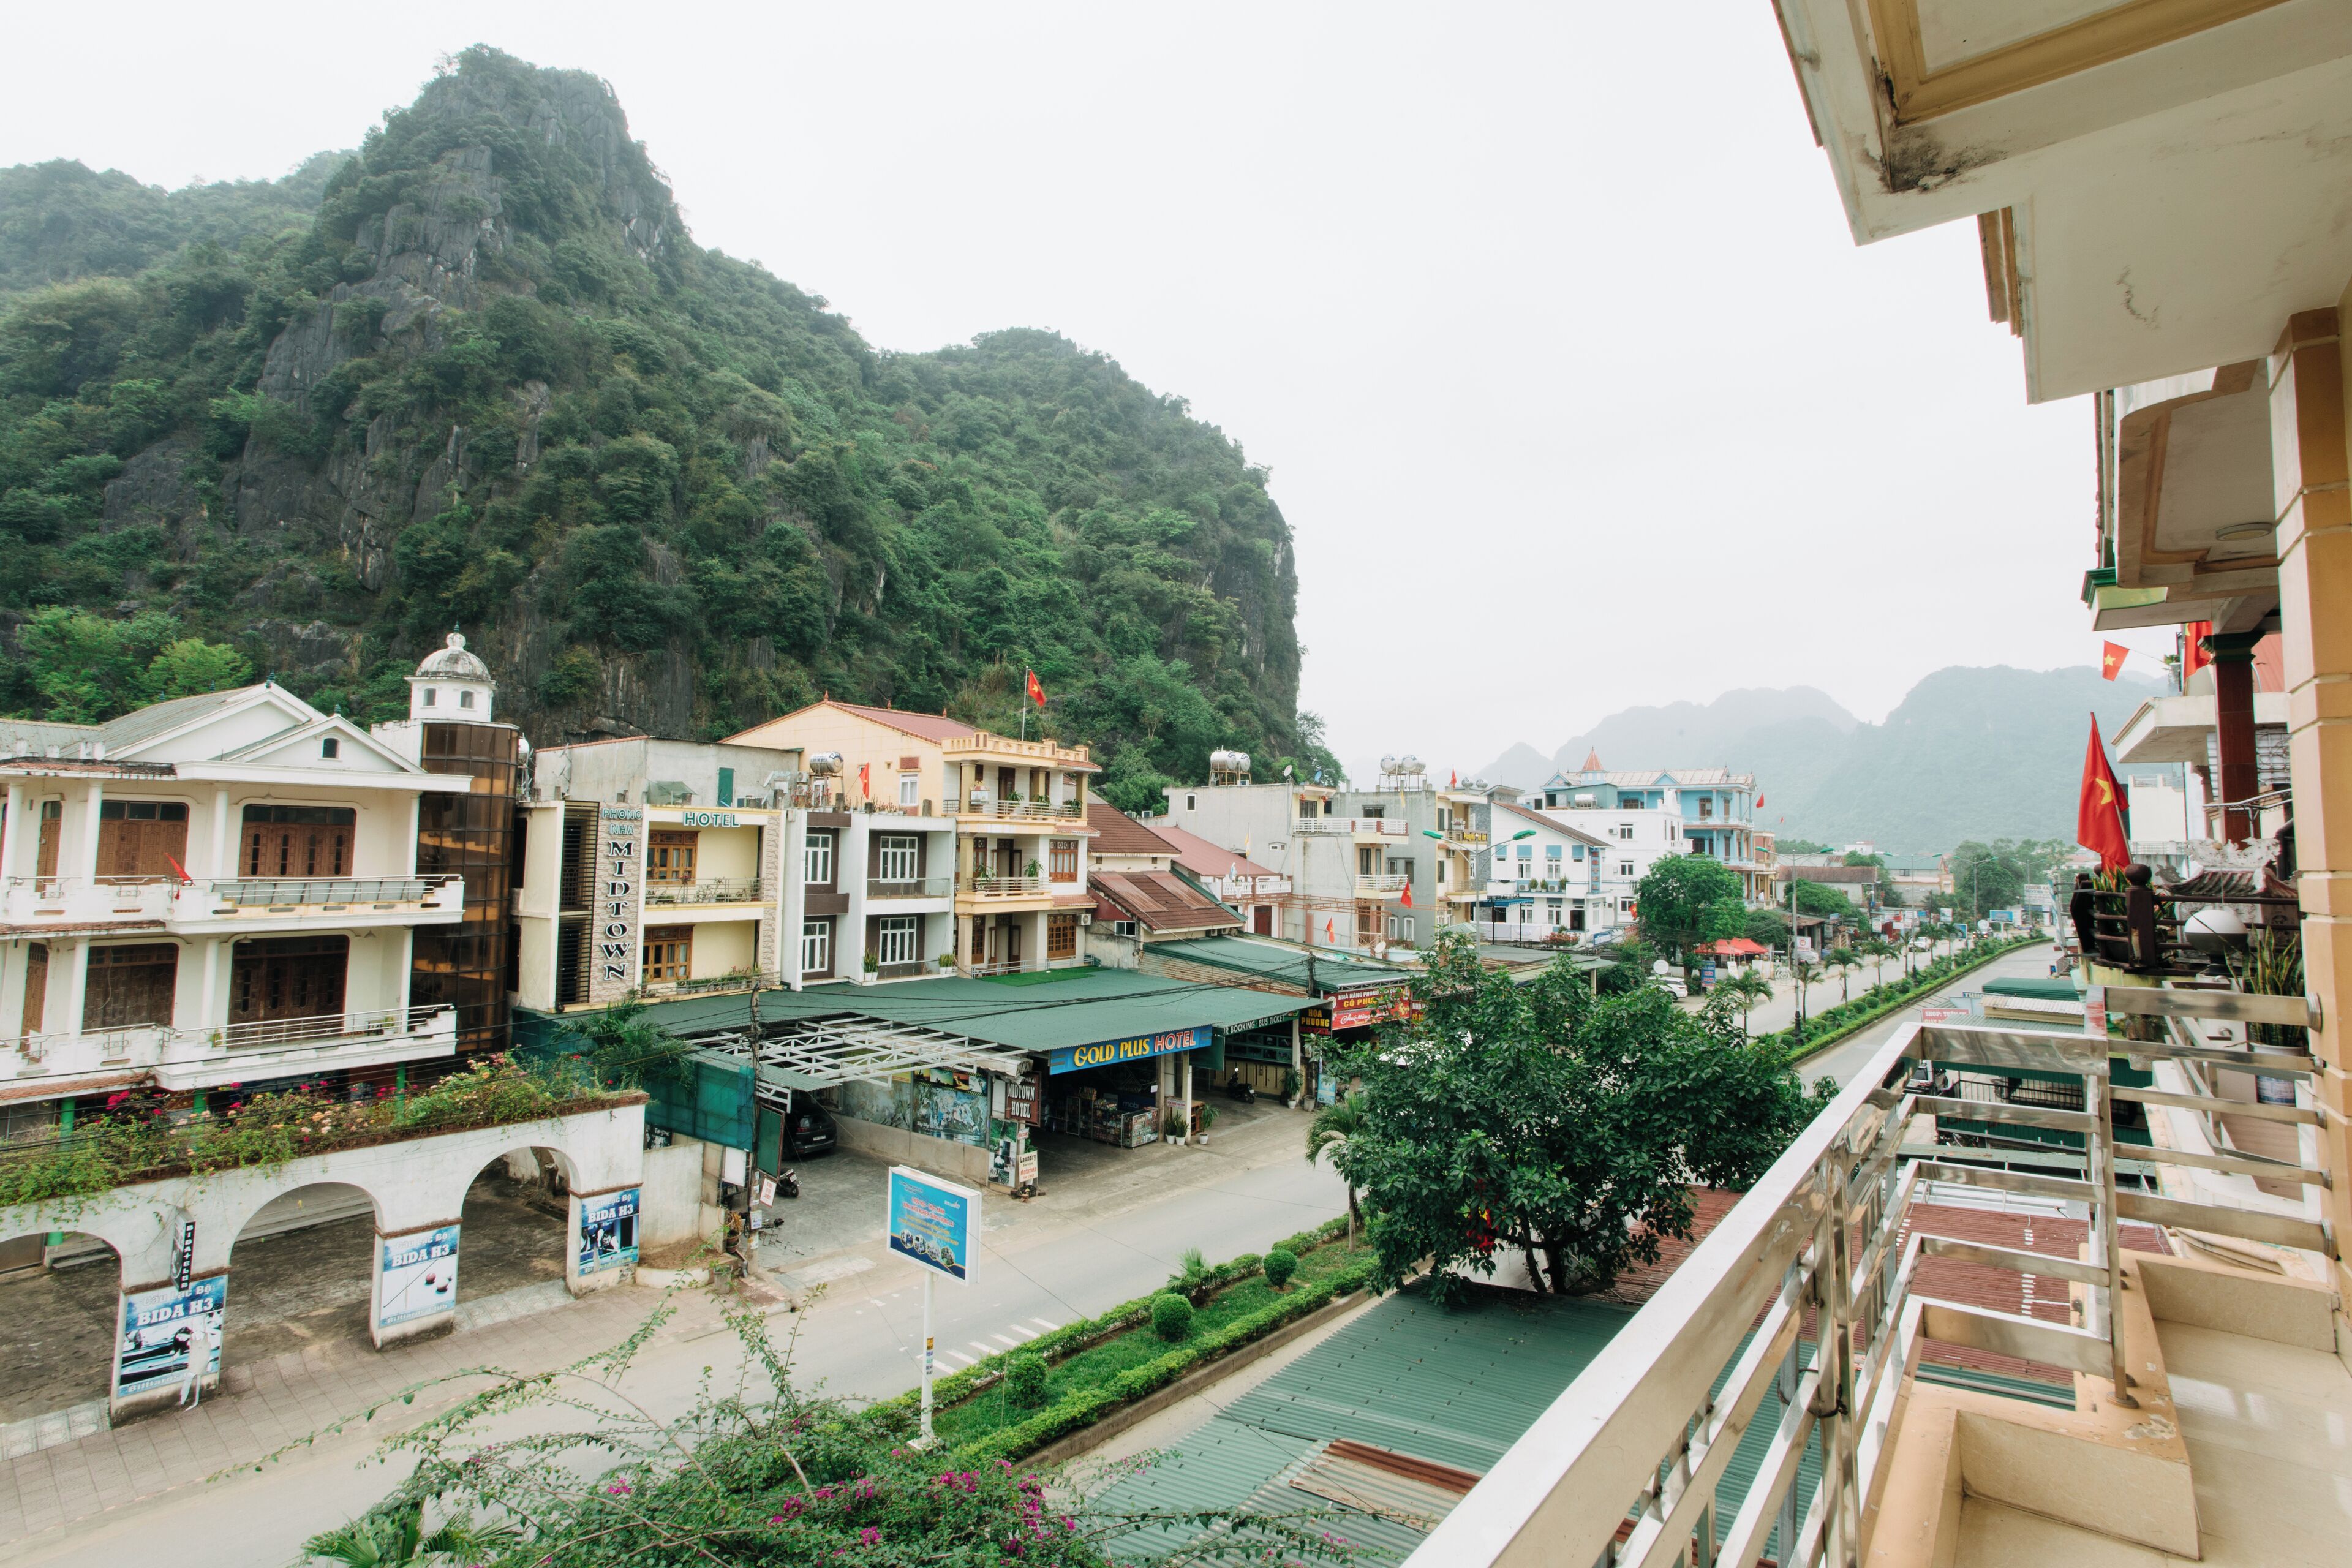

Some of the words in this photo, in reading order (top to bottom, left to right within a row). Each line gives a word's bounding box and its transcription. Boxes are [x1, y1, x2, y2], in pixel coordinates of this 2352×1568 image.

[601, 809, 643, 820] PHONG
[683, 810, 741, 828] HOTEL
[609, 823, 635, 835] NHA
[600, 840, 635, 981] MIDTOWN
[1343, 998, 1355, 1008] CÔ
[1308, 1009, 1322, 1017] HOA
[1230, 1020, 1255, 1034] BOOKING
[1259, 1017, 1268, 1028] BUS
[1270, 1014, 1285, 1025] TICKET
[1301, 1017, 1330, 1027] PHUONG
[1074, 1042, 1115, 1067] GOLD
[1120, 1038, 1150, 1059] PLUS
[1154, 1030, 1196, 1053] HOTEL
[1008, 1084, 1035, 1101] MIDTOWN
[1011, 1101, 1031, 1118] HOTEL
[1020, 1154, 1036, 1163] Laundry
[588, 1208, 616, 1223] BIDA
[619, 1204, 634, 1217] H3
[392, 1248, 428, 1267] BIDA
[431, 1244, 449, 1259] H3
[195, 1283, 212, 1295] Bộ
[137, 1303, 184, 1327] BIDA
[189, 1297, 214, 1314] H3
